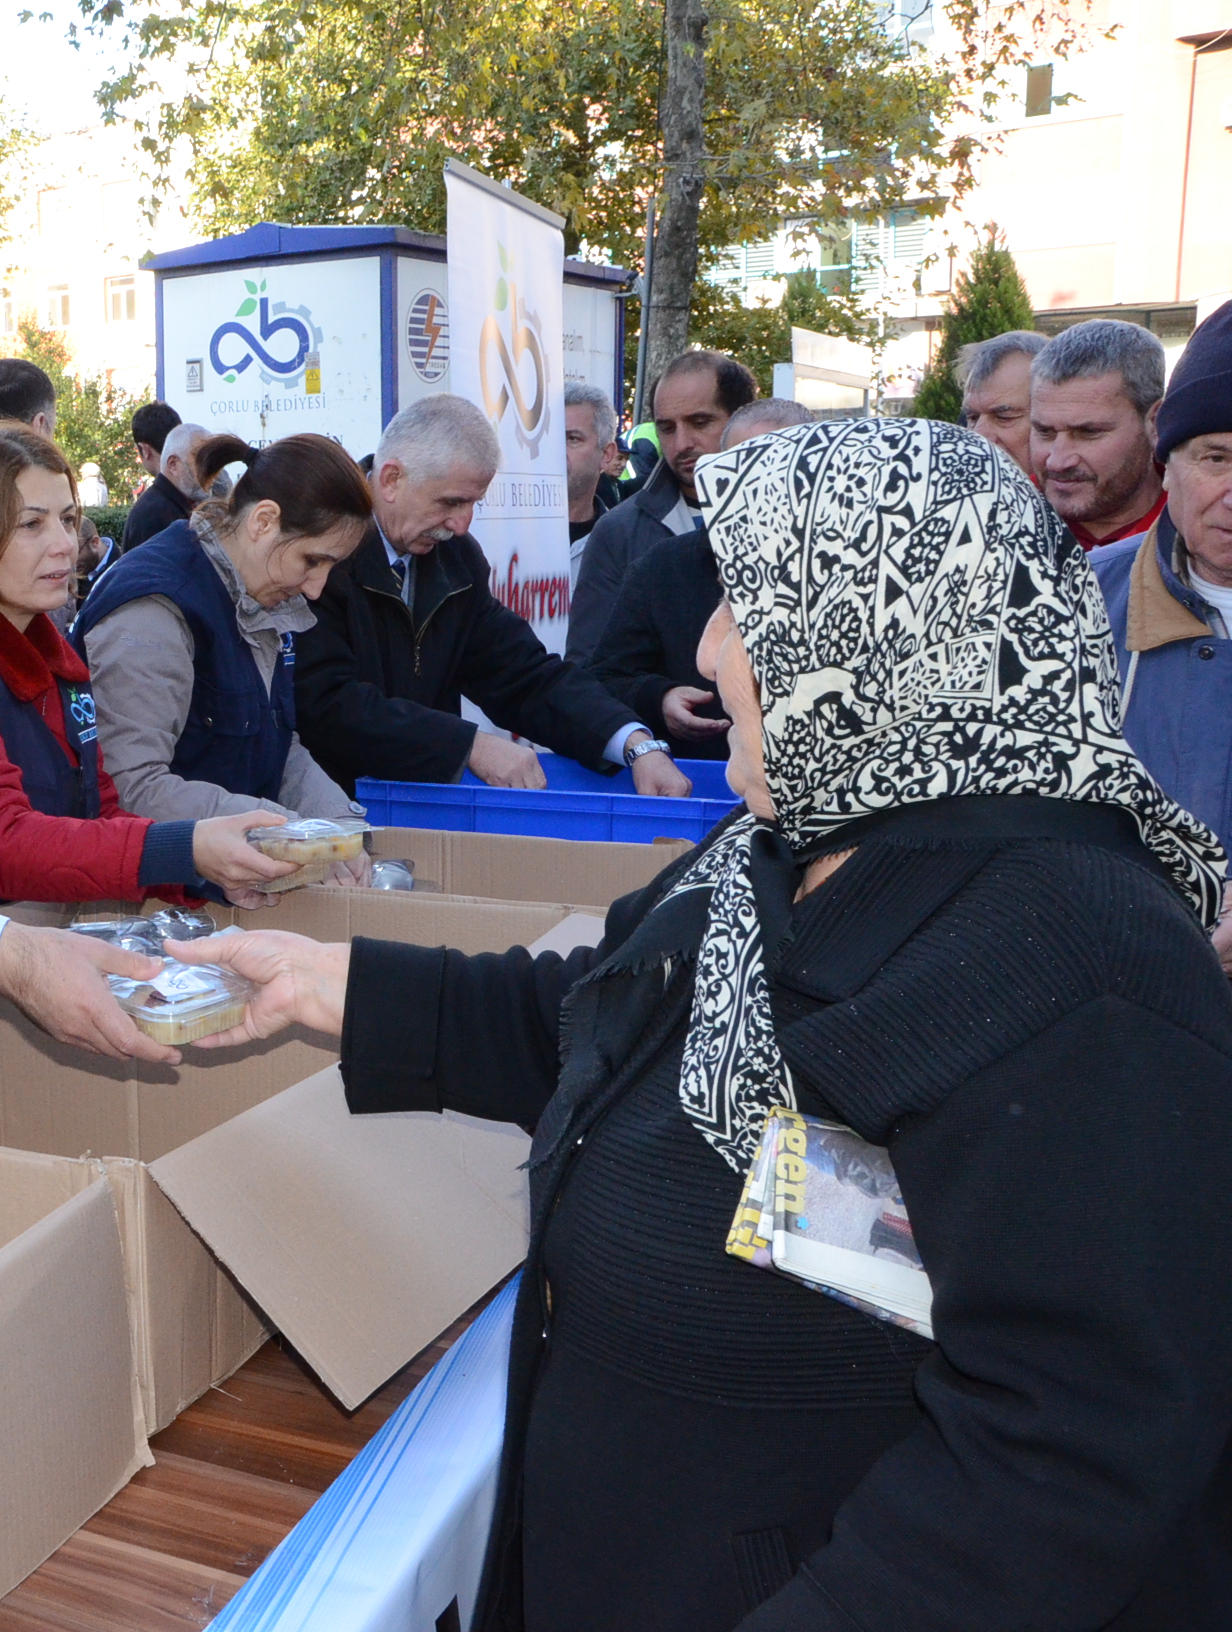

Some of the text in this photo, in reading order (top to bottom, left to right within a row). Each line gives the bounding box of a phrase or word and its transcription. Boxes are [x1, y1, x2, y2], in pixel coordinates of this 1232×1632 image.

[210, 392, 327, 416] ÇORLU BELEDİYESİ
[511, 479, 565, 507] BELEDİYESİ
